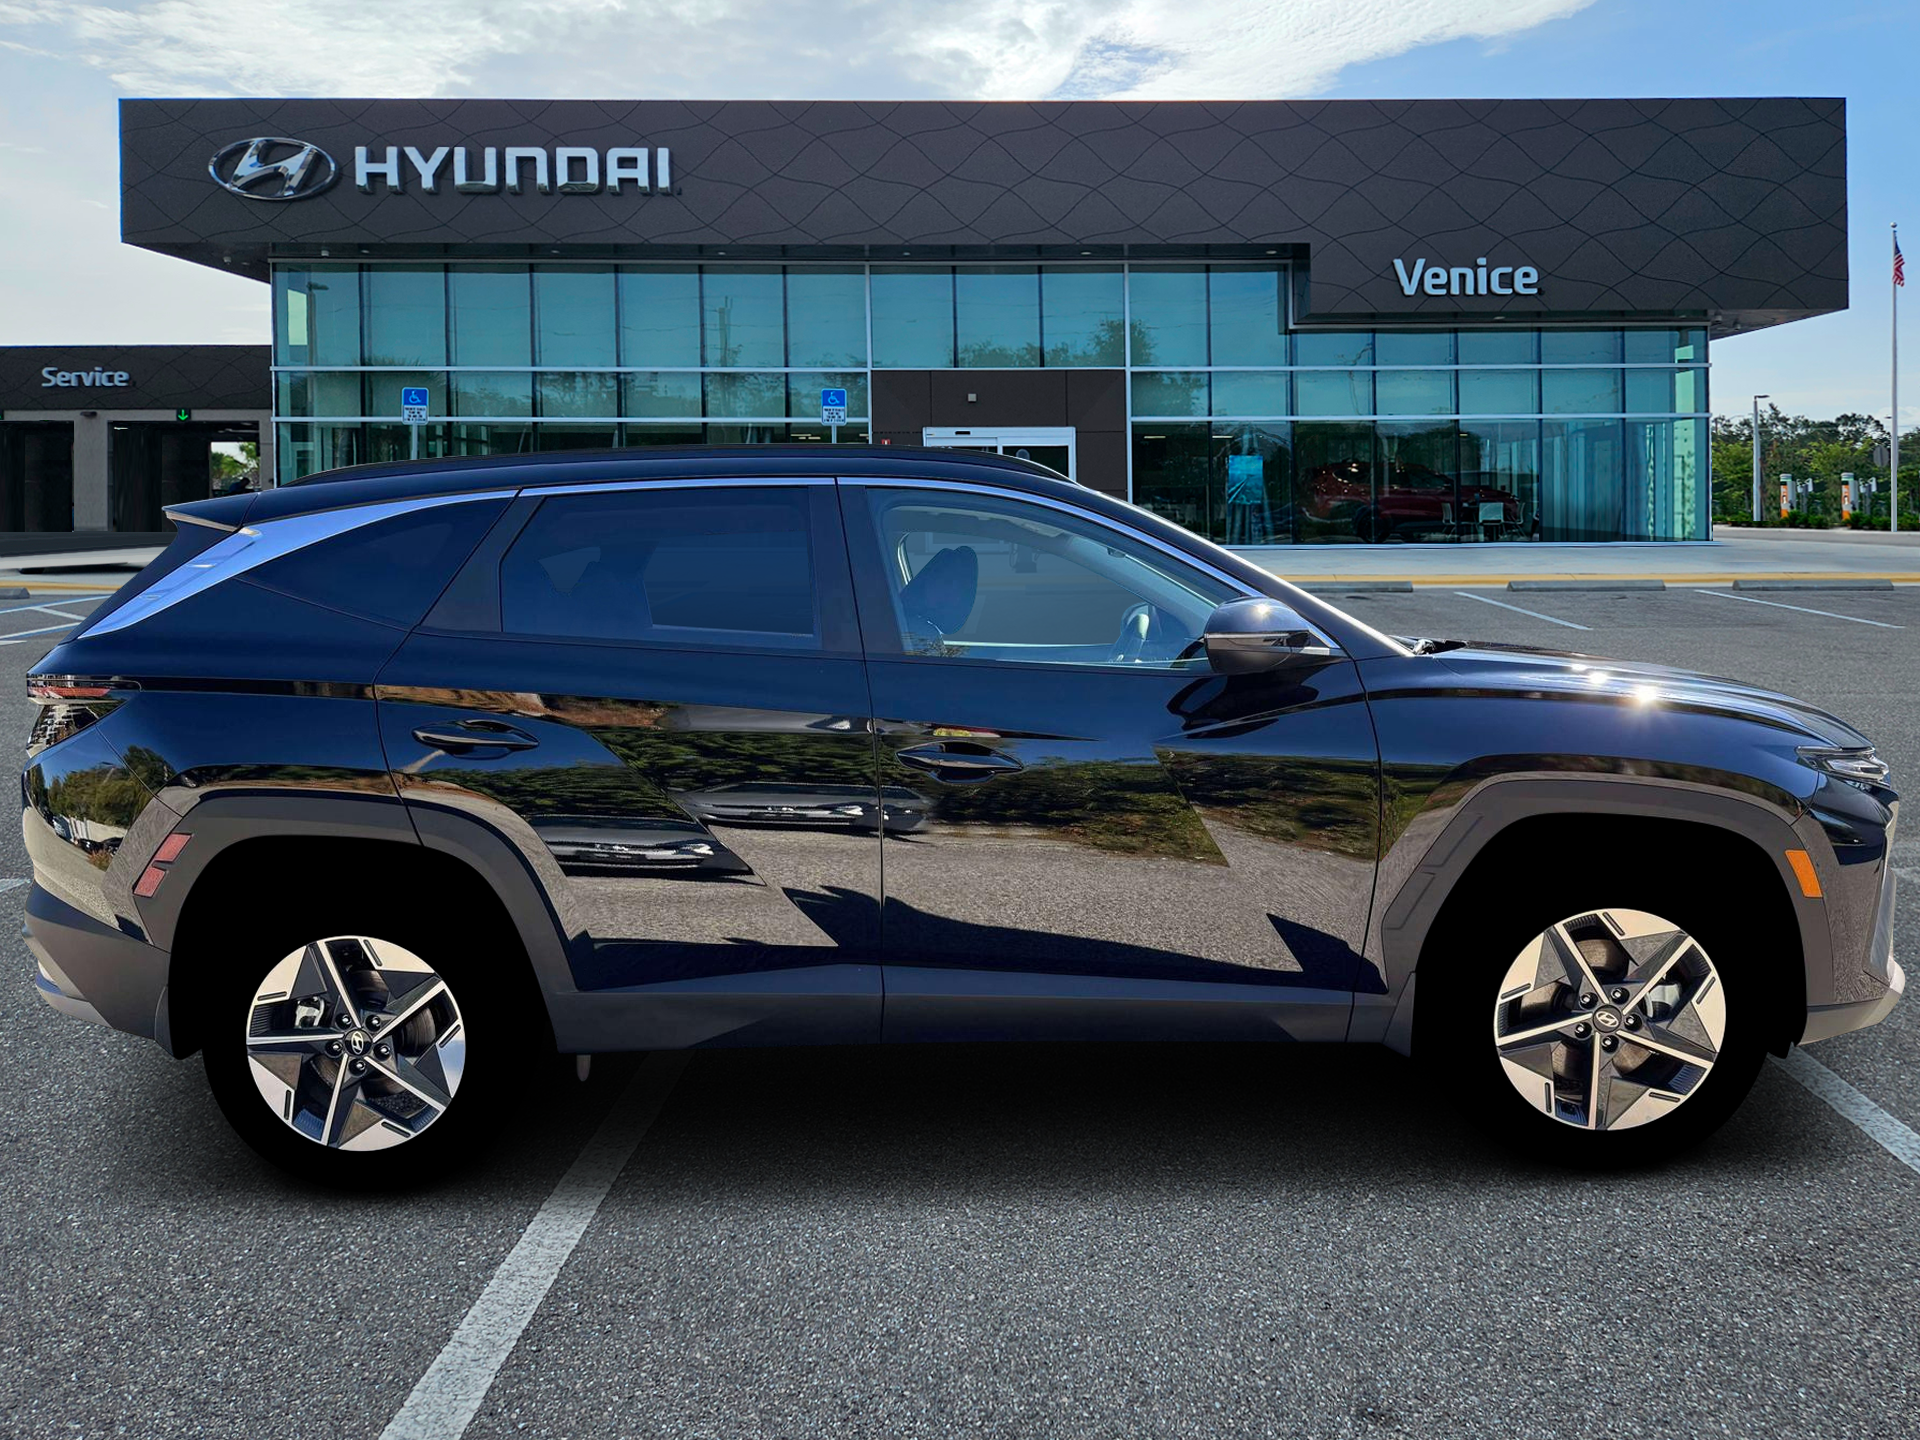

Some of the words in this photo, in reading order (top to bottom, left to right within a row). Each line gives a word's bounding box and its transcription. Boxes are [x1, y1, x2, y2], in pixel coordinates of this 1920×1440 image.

[354, 146, 672, 194] HYUNDAI
[1392, 257, 1539, 296] Venice
[41, 366, 130, 388] Service
